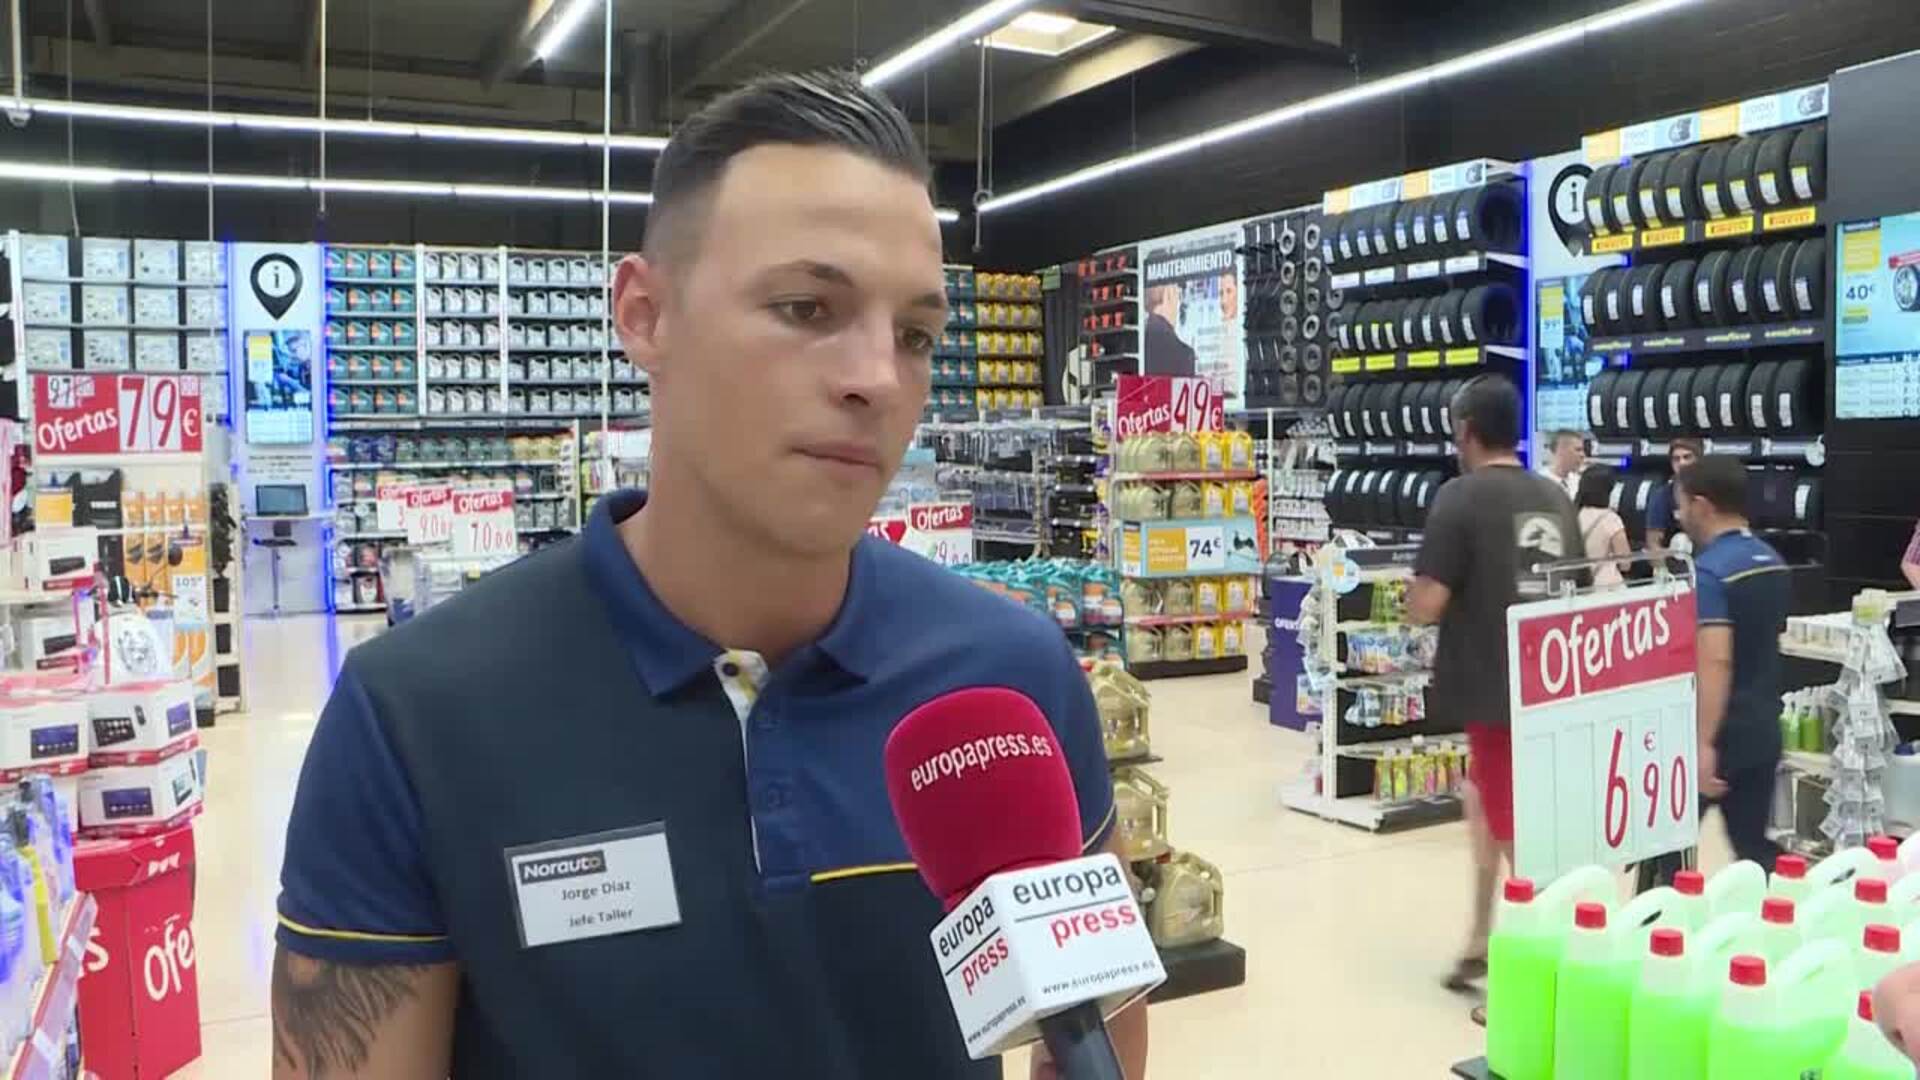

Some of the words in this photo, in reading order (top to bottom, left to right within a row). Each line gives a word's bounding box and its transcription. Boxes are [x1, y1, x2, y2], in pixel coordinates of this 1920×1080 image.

[1147, 250, 1232, 281] MANTENIMIENTO
[38, 407, 118, 451] Ofertas
[1118, 403, 1171, 435] Ofertas
[459, 491, 505, 513] Ofertas
[916, 506, 964, 530] Ofertas
[1189, 537, 1222, 559] 74€
[1539, 599, 1671, 697] Ofertas
[910, 732, 1053, 793] europapress.es
[523, 855, 602, 880] Norauto
[1012, 863, 1123, 906] europa
[562, 887, 598, 901] Jorge
[569, 914, 595, 928] Jefe
[599, 908, 633, 922] Taller
[938, 895, 996, 957] europa
[1050, 902, 1137, 949] press
[962, 936, 1009, 996] press
[1042, 960, 1156, 996] www.europapress.es
